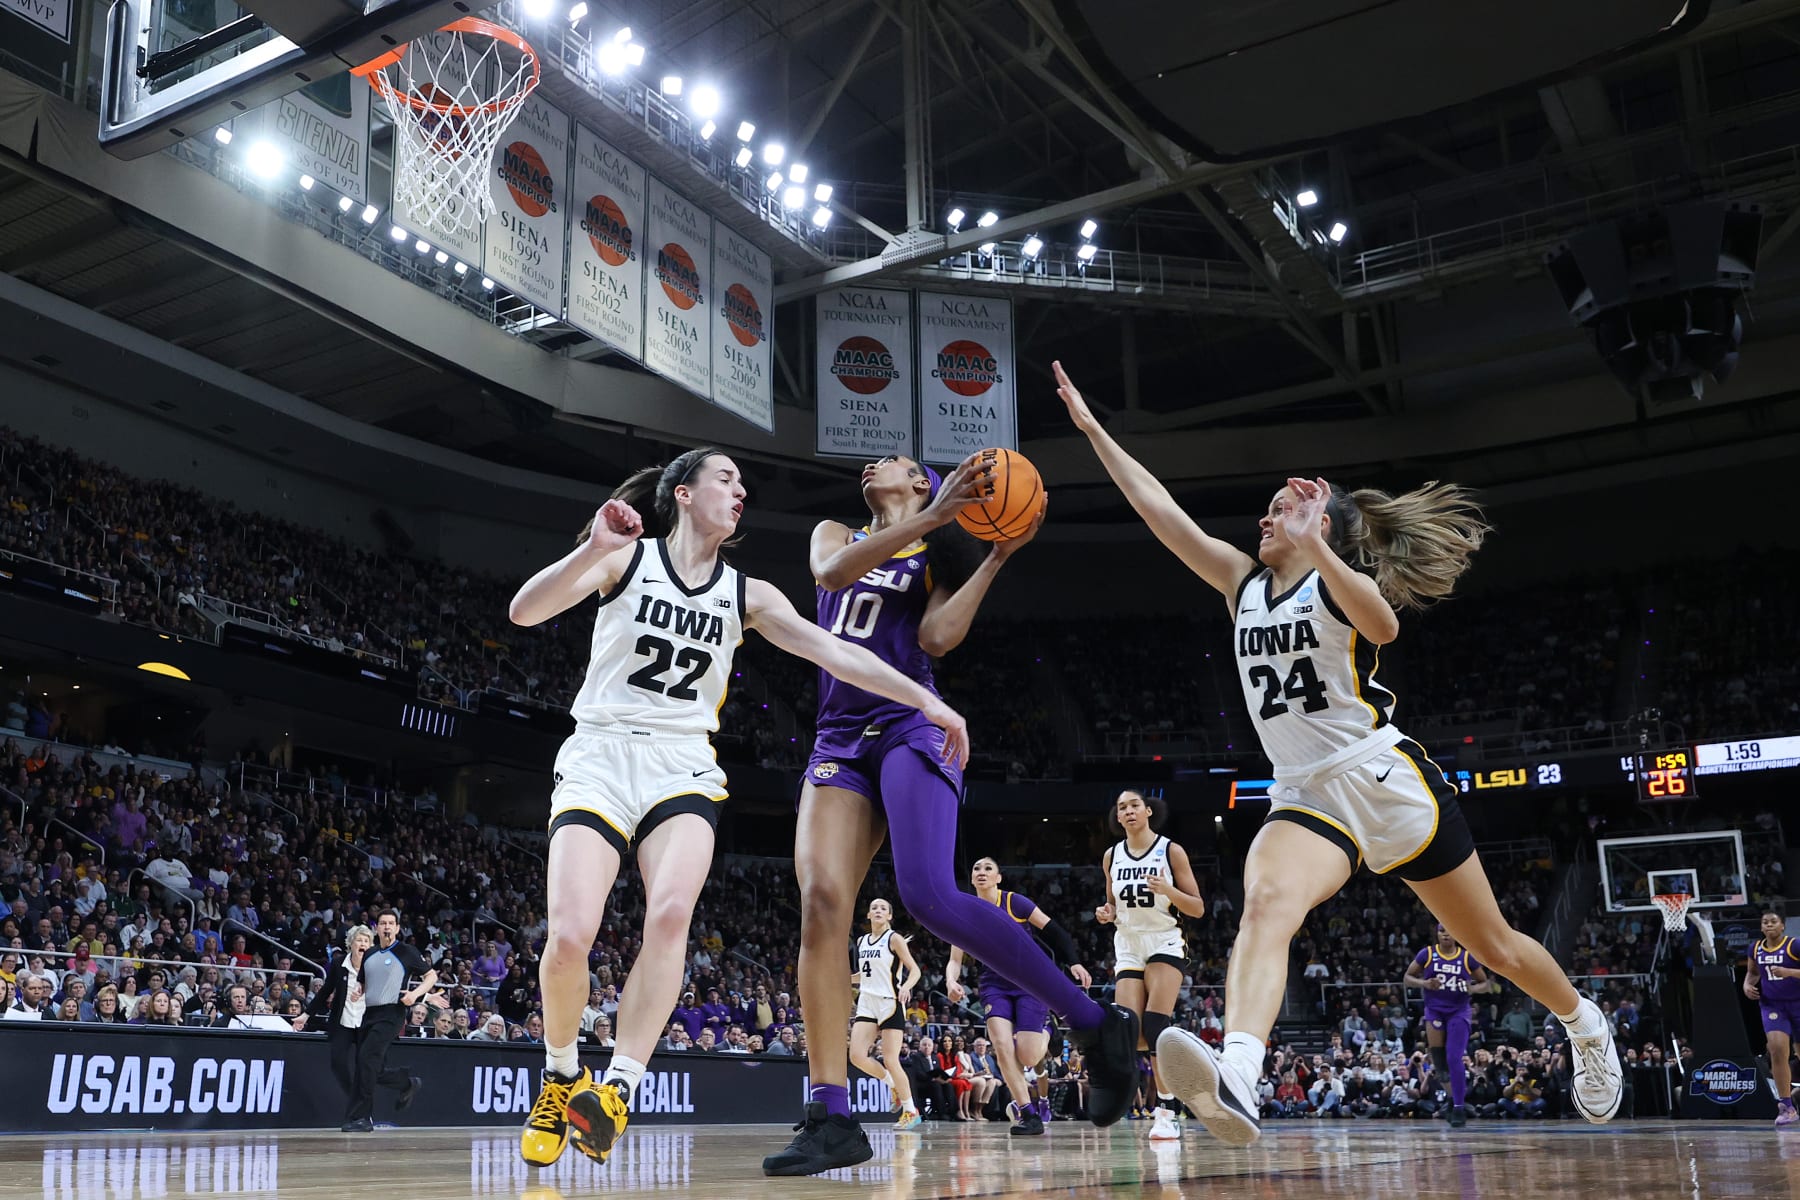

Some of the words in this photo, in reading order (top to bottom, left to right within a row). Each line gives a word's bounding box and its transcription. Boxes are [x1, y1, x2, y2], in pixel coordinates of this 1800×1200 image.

[276, 98, 360, 176] SIENA
[503, 147, 554, 194] MAAC
[593, 143, 629, 180] NCAA
[336, 172, 361, 195] 1973
[497, 166, 557, 213] CHAMPIONS
[580, 154, 641, 202] TOURNAMENT
[585, 201, 632, 244] MAAC
[663, 193, 697, 229] NCAA
[501, 211, 549, 252] SIENA
[652, 204, 708, 249] TOURNAMENT
[510, 236, 541, 266] 1999
[580, 219, 636, 262] CHAMPIONS
[728, 237, 758, 268] NCAA
[493, 246, 519, 270] FIRST
[521, 262, 555, 290] ROUND
[583, 260, 629, 300] SIENA
[658, 249, 700, 289] MAAC
[590, 284, 621, 314] 2002
[654, 267, 704, 305] CHAMPIONS
[724, 289, 763, 327] MAAC
[838, 292, 887, 310] NCAA
[941, 300, 989, 318] NCAA
[576, 294, 600, 317] FIRST
[602, 309, 634, 335] ROUND
[657, 306, 698, 342] SIENA
[720, 306, 767, 342] CHAMPIONS
[824, 310, 904, 326] TOURNAMENT
[926, 316, 1006, 332] TOURNAMENT
[664, 329, 693, 356] 2008
[724, 344, 762, 377] SIENA
[835, 349, 893, 367] MAAC
[937, 352, 998, 372] MAAC
[730, 365, 757, 390] 2009
[830, 365, 900, 380] CHAMPIONS
[931, 368, 1003, 384] CHAMPIONS
[840, 399, 889, 413] SIENA
[938, 402, 997, 419] SIENA
[825, 426, 858, 438] FIRST
[862, 428, 906, 441] ROUND
[850, 414, 881, 428] 2010
[950, 421, 988, 434] 2020
[832, 439, 857, 449] South
[860, 440, 898, 451] Regional
[953, 435, 985, 446] NCAA
[858, 568, 913, 592] SU
[635, 594, 724, 646] IOWA
[831, 588, 884, 640] 10
[1239, 619, 1320, 657] IOWA
[627, 634, 713, 701] 22
[1248, 656, 1329, 721] 24
[1656, 753, 1687, 769] 1:59
[1724, 742, 1761, 761] 1:59
[1474, 768, 1528, 790] LSU
[1537, 764, 1562, 785] 23
[1694, 763, 1740, 775] BASKETBALL
[1460, 780, 1470, 793] 3
[1648, 769, 1686, 796] 26
[1117, 866, 1158, 881] IOWA
[1119, 884, 1155, 909] 45
[862, 960, 872, 978] 4
[1433, 962, 1461, 975] LSU
[1758, 955, 1784, 965] LSU
[1765, 965, 1783, 981] 1
[47, 1054, 285, 1114] USAB.COM
[1704, 1071, 1738, 1081] MARCH
[1709, 1081, 1755, 1090] MADNESS
[472, 1066, 531, 1113] USA
